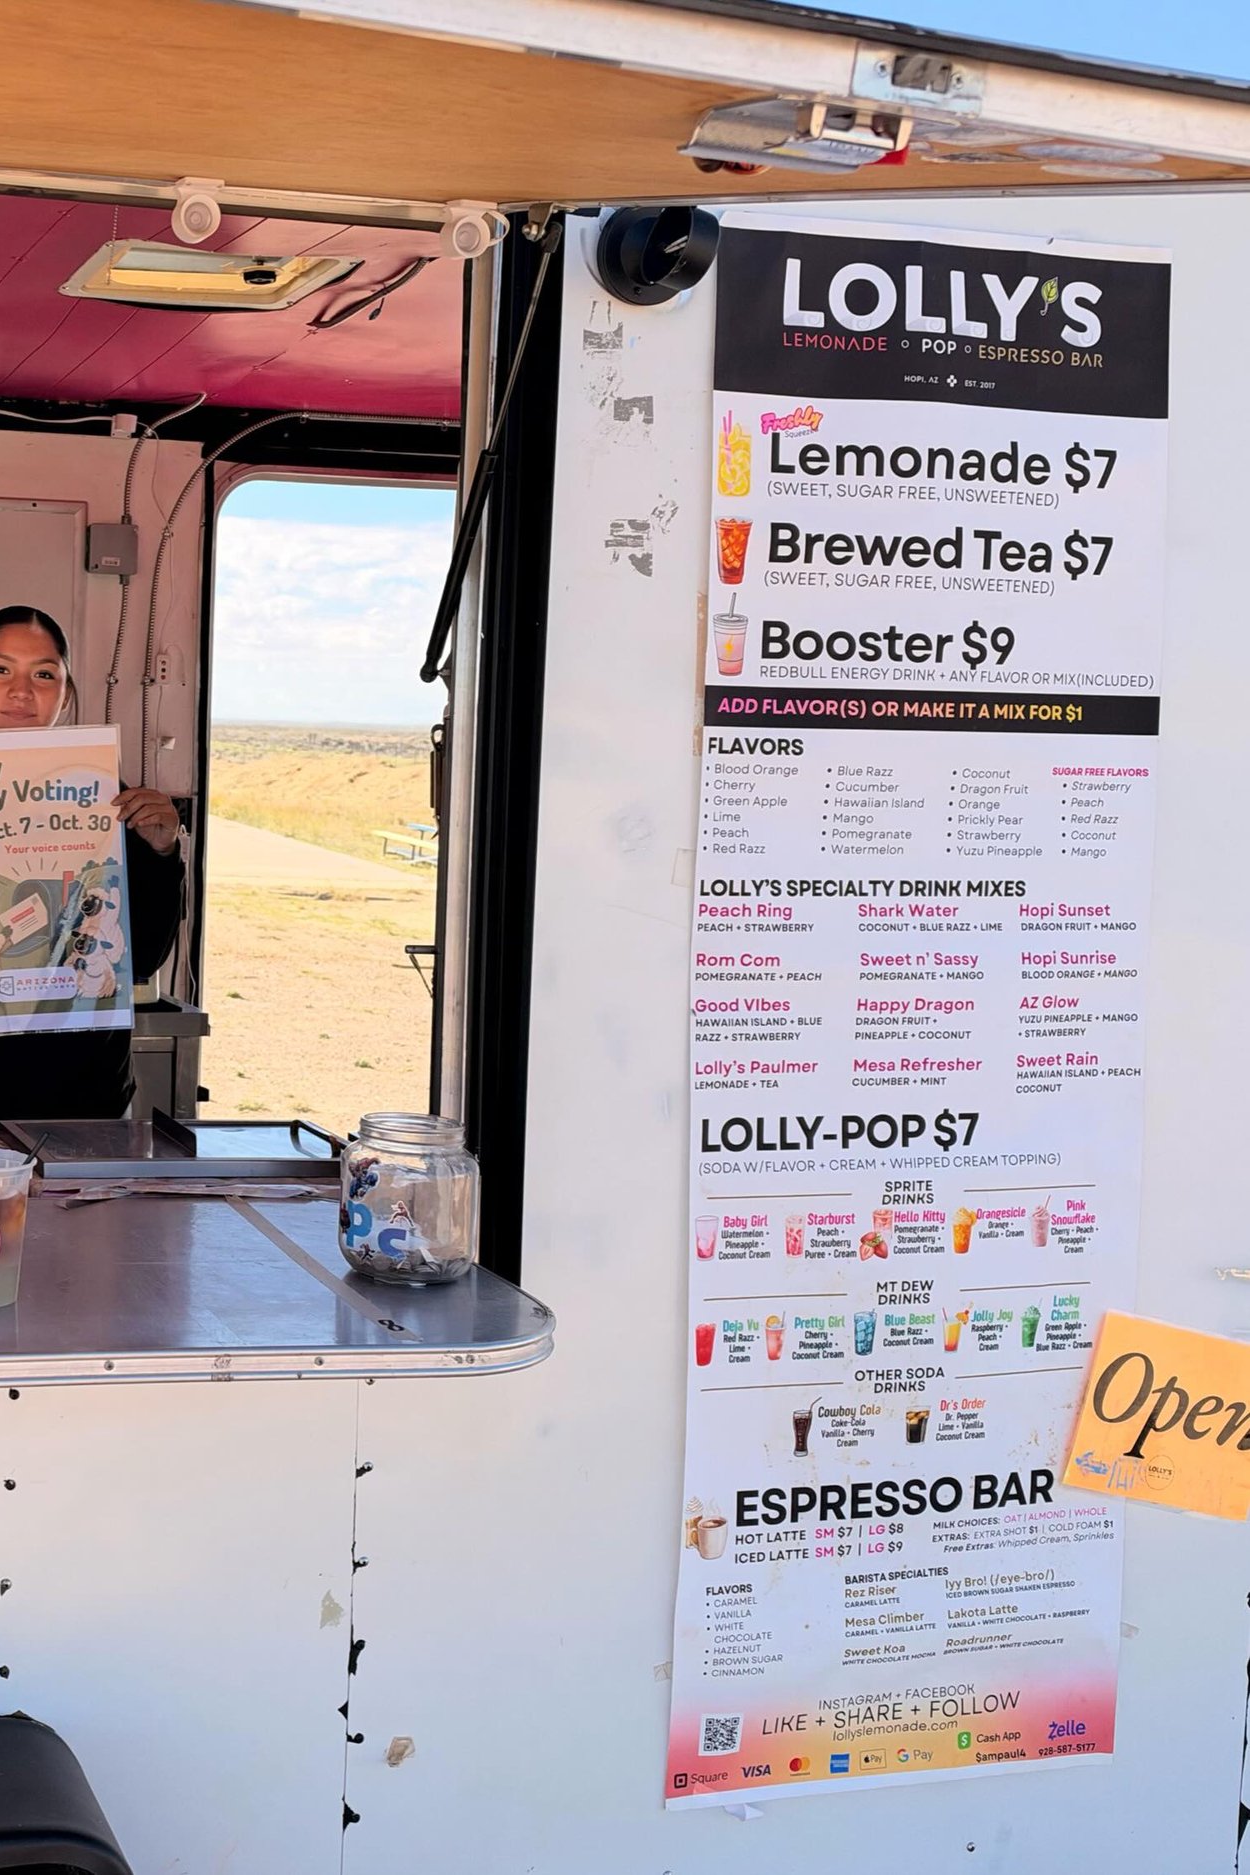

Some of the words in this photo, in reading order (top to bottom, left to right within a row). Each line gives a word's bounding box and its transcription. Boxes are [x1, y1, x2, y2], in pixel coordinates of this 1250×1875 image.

[783, 258, 1102, 347] LOLLY'S
[783, 332, 887, 351] LEMONADE
[922, 339, 956, 354] POP
[978, 345, 1063, 364] ESPRESSO
[1070, 352, 1102, 367] BAR
[928, 375, 938, 383] AZ
[965, 379, 978, 388] EST.
[980, 381, 995, 389] 2017
[761, 406, 823, 436] Freshly
[770, 432, 1049, 484] Lemonade
[1065, 442, 1117, 493] $7
[767, 482, 829, 498] (SWEET,
[837, 484, 892, 499] SUGAR
[899, 486, 940, 502] FREE,
[945, 488, 1059, 509] UNSWEETENED)
[768, 523, 962, 569] Brewed
[974, 530, 1052, 573] Tea
[1063, 530, 1113, 580] $7
[764, 572, 829, 589] (SWEET,
[835, 573, 890, 588] SUGAR
[895, 575, 937, 591] FREE,
[942, 577, 1054, 595] UNSWEETENED)
[760, 621, 952, 663] Booster
[962, 621, 1015, 670] $9
[760, 666, 828, 680] REDBULL
[831, 667, 888, 680] ENERGY
[893, 668, 935, 681] DRINK
[950, 671, 976, 682] ANY
[981, 671, 1029, 683] FLAVOR
[1032, 672, 1049, 684] OR
[1053, 672, 1154, 690] MIX(INCLUDED)
[718, 698, 757, 713] ADD
[763, 699, 867, 719] FLAVOR(S)
[872, 701, 899, 717] OR
[903, 702, 955, 718] MAKE
[960, 703, 976, 718] IT
[979, 704, 990, 718] A
[994, 705, 1025, 719] MIX
[1030, 705, 1061, 720] FOR
[1066, 704, 1082, 722] $1
[708, 737, 803, 756] FLAVORS
[1052, 767, 1083, 776] SUGAR
[1085, 768, 1106, 776] FREE
[1107, 768, 1149, 777] FLAVORS
[12, 780, 99, 807] Voting!
[713, 780, 755, 793] Cherry
[836, 781, 899, 793] Cucumber
[1072, 781, 1131, 794] Strawberry
[20, 817, 31, 834] 7
[50, 814, 82, 831] Oct.
[88, 815, 111, 832] 30
[833, 814, 874, 826] Mango
[832, 828, 912, 840] Pomegranate
[5, 844, 28, 854] Your
[31, 844, 58, 853] voice
[61, 841, 95, 851] counts
[831, 844, 904, 855] Watermelon
[700, 880, 782, 898] LOLLY'S
[787, 880, 893, 898] SPECIALTY
[899, 880, 960, 898] DRINK
[966, 880, 1025, 897] MIXES
[698, 903, 751, 918] Peach
[757, 903, 792, 921] Ring
[858, 903, 903, 917] Shark
[908, 904, 958, 918] Water
[1020, 904, 1054, 920] Hopi
[1058, 903, 1111, 917] Sunset
[17, 976, 74, 985] ARIZONA
[857, 998, 909, 1014] Happy
[915, 998, 974, 1014] Dragon
[701, 1112, 925, 1152] LOLLY-POP
[934, 1108, 979, 1151] $7
[885, 1180, 933, 1193] SPRITE
[882, 1192, 934, 1204] DRINKS
[808, 1213, 855, 1225] Starburst
[976, 1207, 1026, 1220] Orangesicle
[877, 1281, 897, 1292] MT
[902, 1280, 933, 1292] DEW
[878, 1291, 930, 1305] DRINKS
[855, 1368, 899, 1381] OTHER
[905, 1367, 944, 1379] SODA
[874, 1380, 925, 1393] DRINKS
[1093, 1353, 1250, 1459] Open
[735, 1478, 963, 1527] ESPRESSO
[974, 1469, 1053, 1509] BAR
[735, 1532, 761, 1544] HOT
[766, 1529, 806, 1542] LATTE
[815, 1527, 834, 1539] SM
[838, 1525, 852, 1539] $7
[869, 1524, 886, 1536] LG
[889, 1522, 903, 1536] $8
[845, 1573, 886, 1583] BARISTA
[888, 1566, 948, 1580] SPECIALTIES
[819, 1692, 891, 1710] INSTAGRAM
[905, 1684, 975, 1700] FACEBOOK
[763, 1713, 807, 1735] LIKE
[834, 1703, 903, 1726] SHARE
[929, 1692, 1020, 1716] FOLLOW
[833, 1719, 958, 1742] lollyslemonade.com
[977, 1732, 1000, 1744] Cash
[1003, 1730, 1021, 1744] App
[1047, 1720, 1086, 1740] Zelle
[691, 1770, 728, 1783] Square
[742, 1765, 771, 1778] VISA
